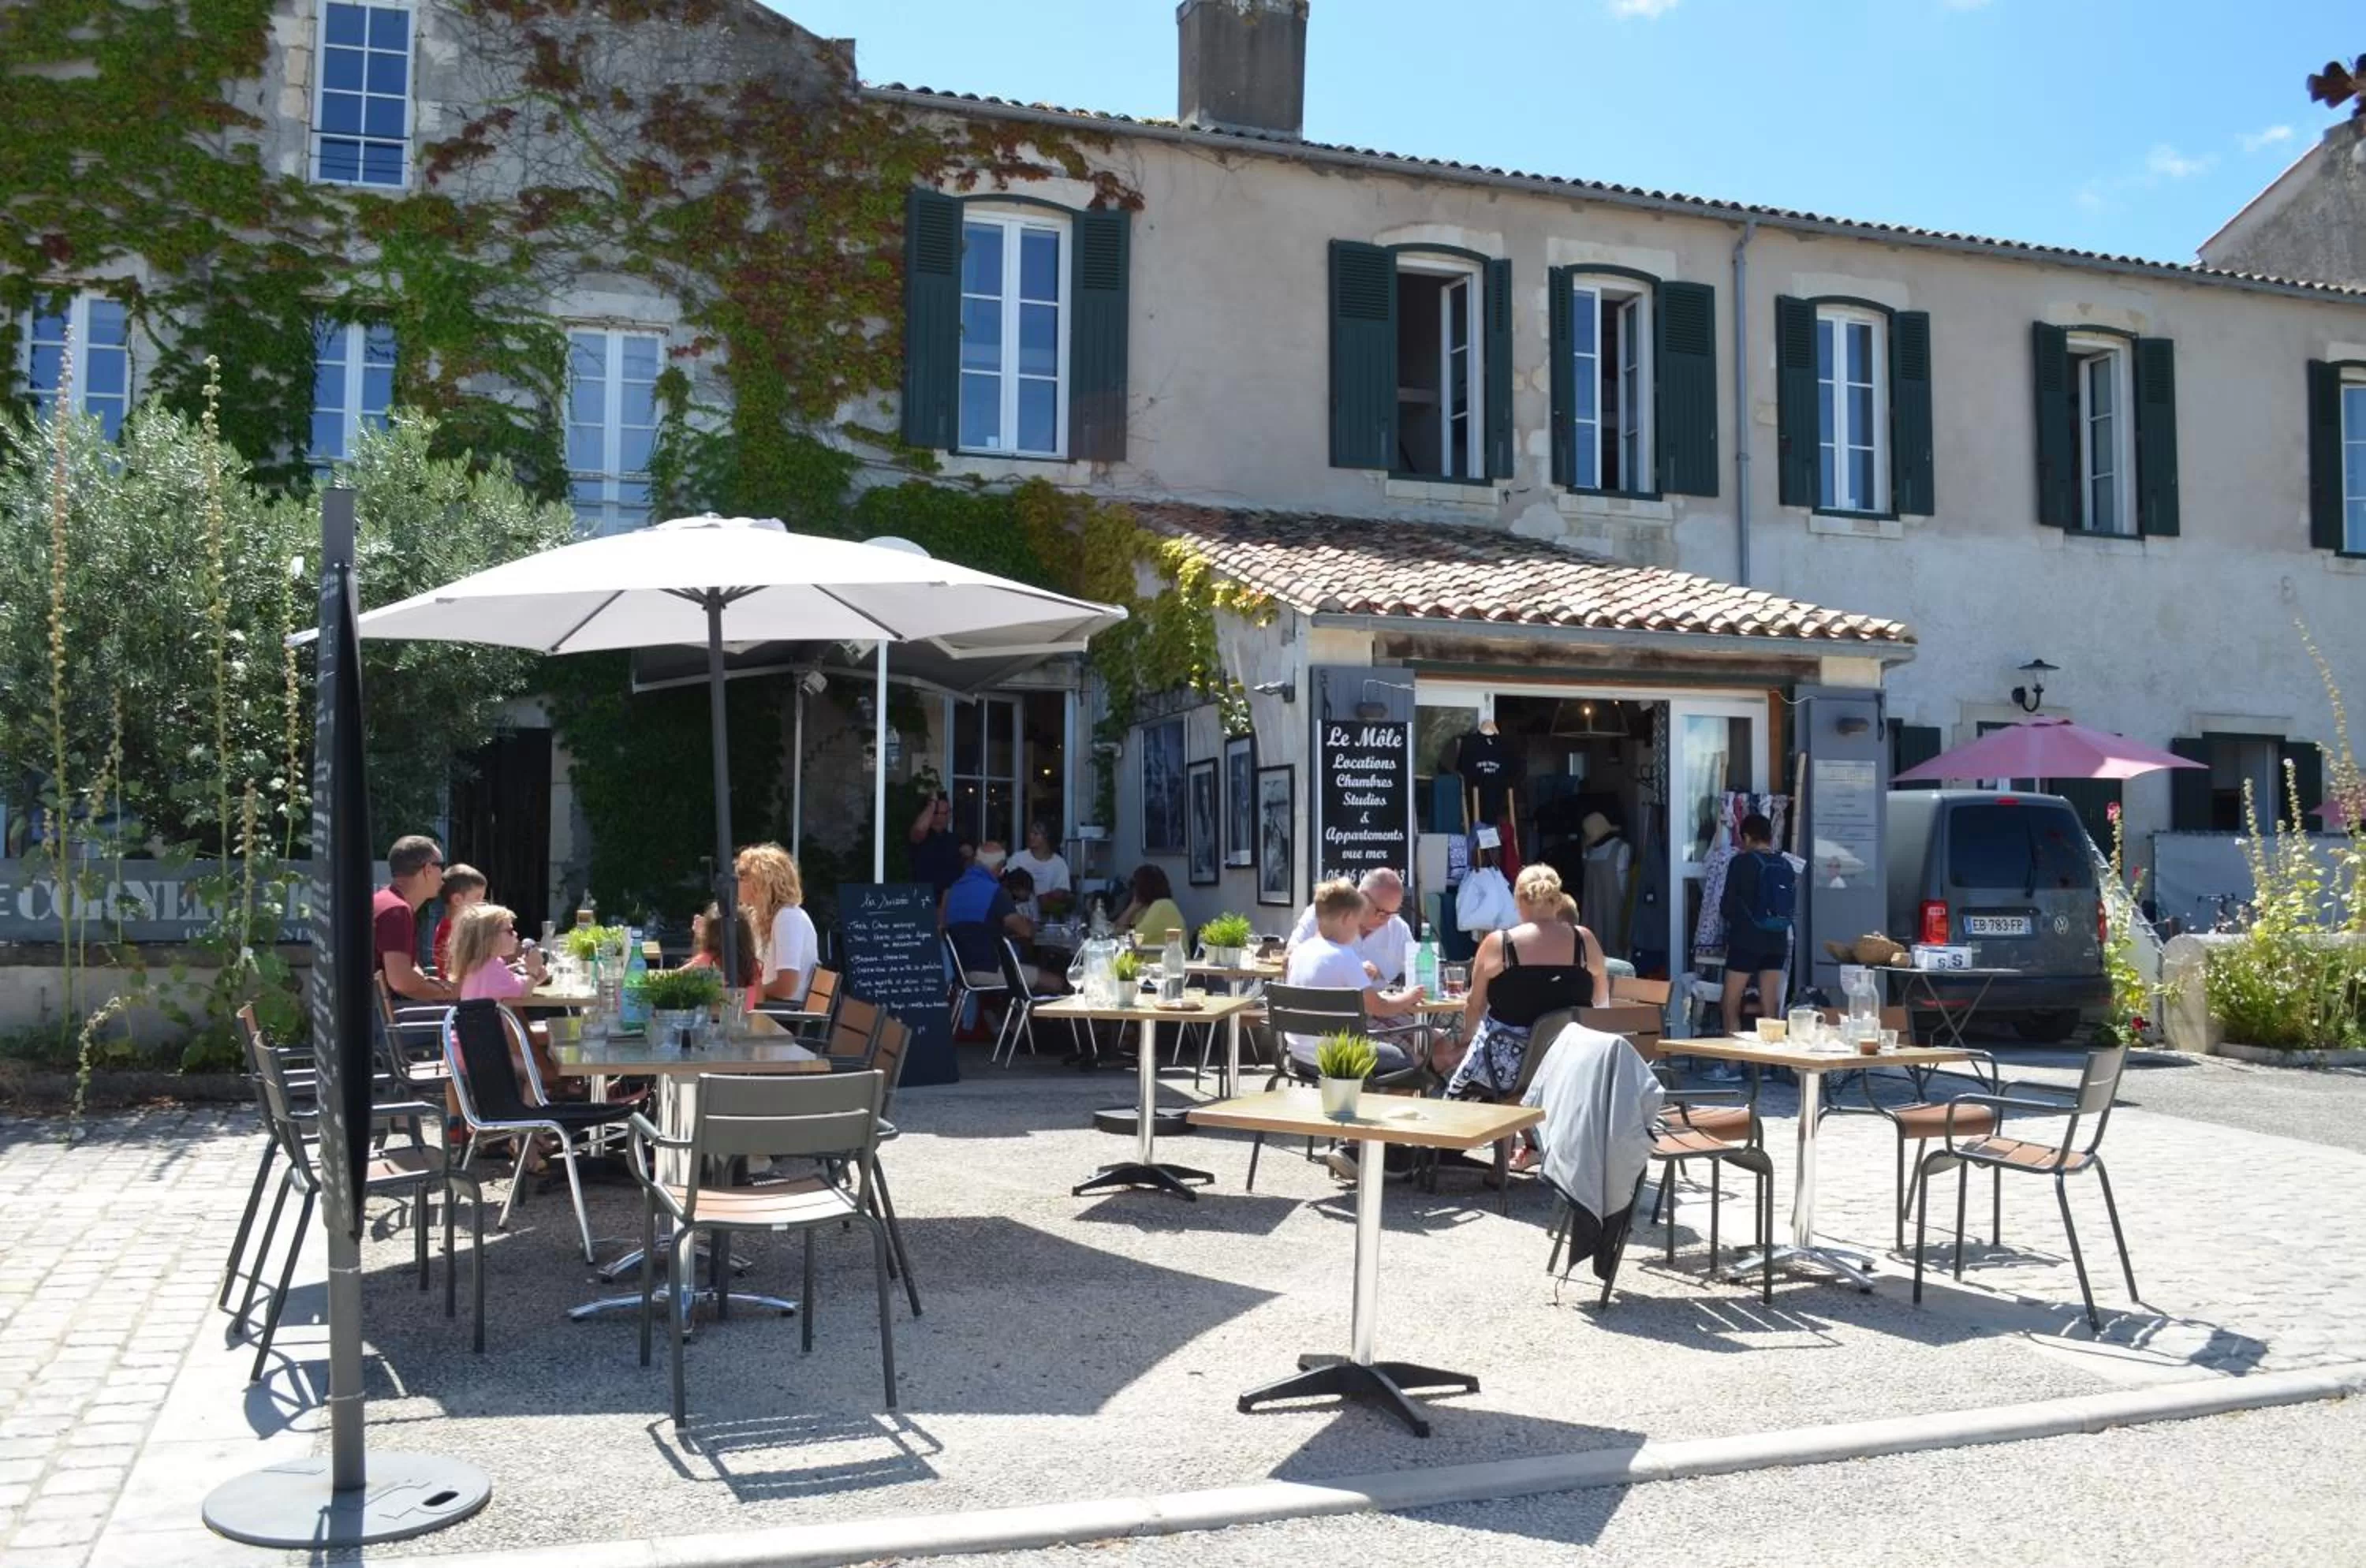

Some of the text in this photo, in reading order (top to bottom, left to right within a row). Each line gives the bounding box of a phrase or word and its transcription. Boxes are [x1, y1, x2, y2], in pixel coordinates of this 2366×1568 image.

[1326, 726, 1403, 748] Le Môle
[1332, 753, 1397, 770] Locations
[1335, 773, 1394, 788] Chambres
[1342, 791, 1387, 807] Studios
[1360, 811, 1370, 824] &
[1325, 826, 1404, 845] Appartements
[1342, 849, 1388, 860] vue mer
